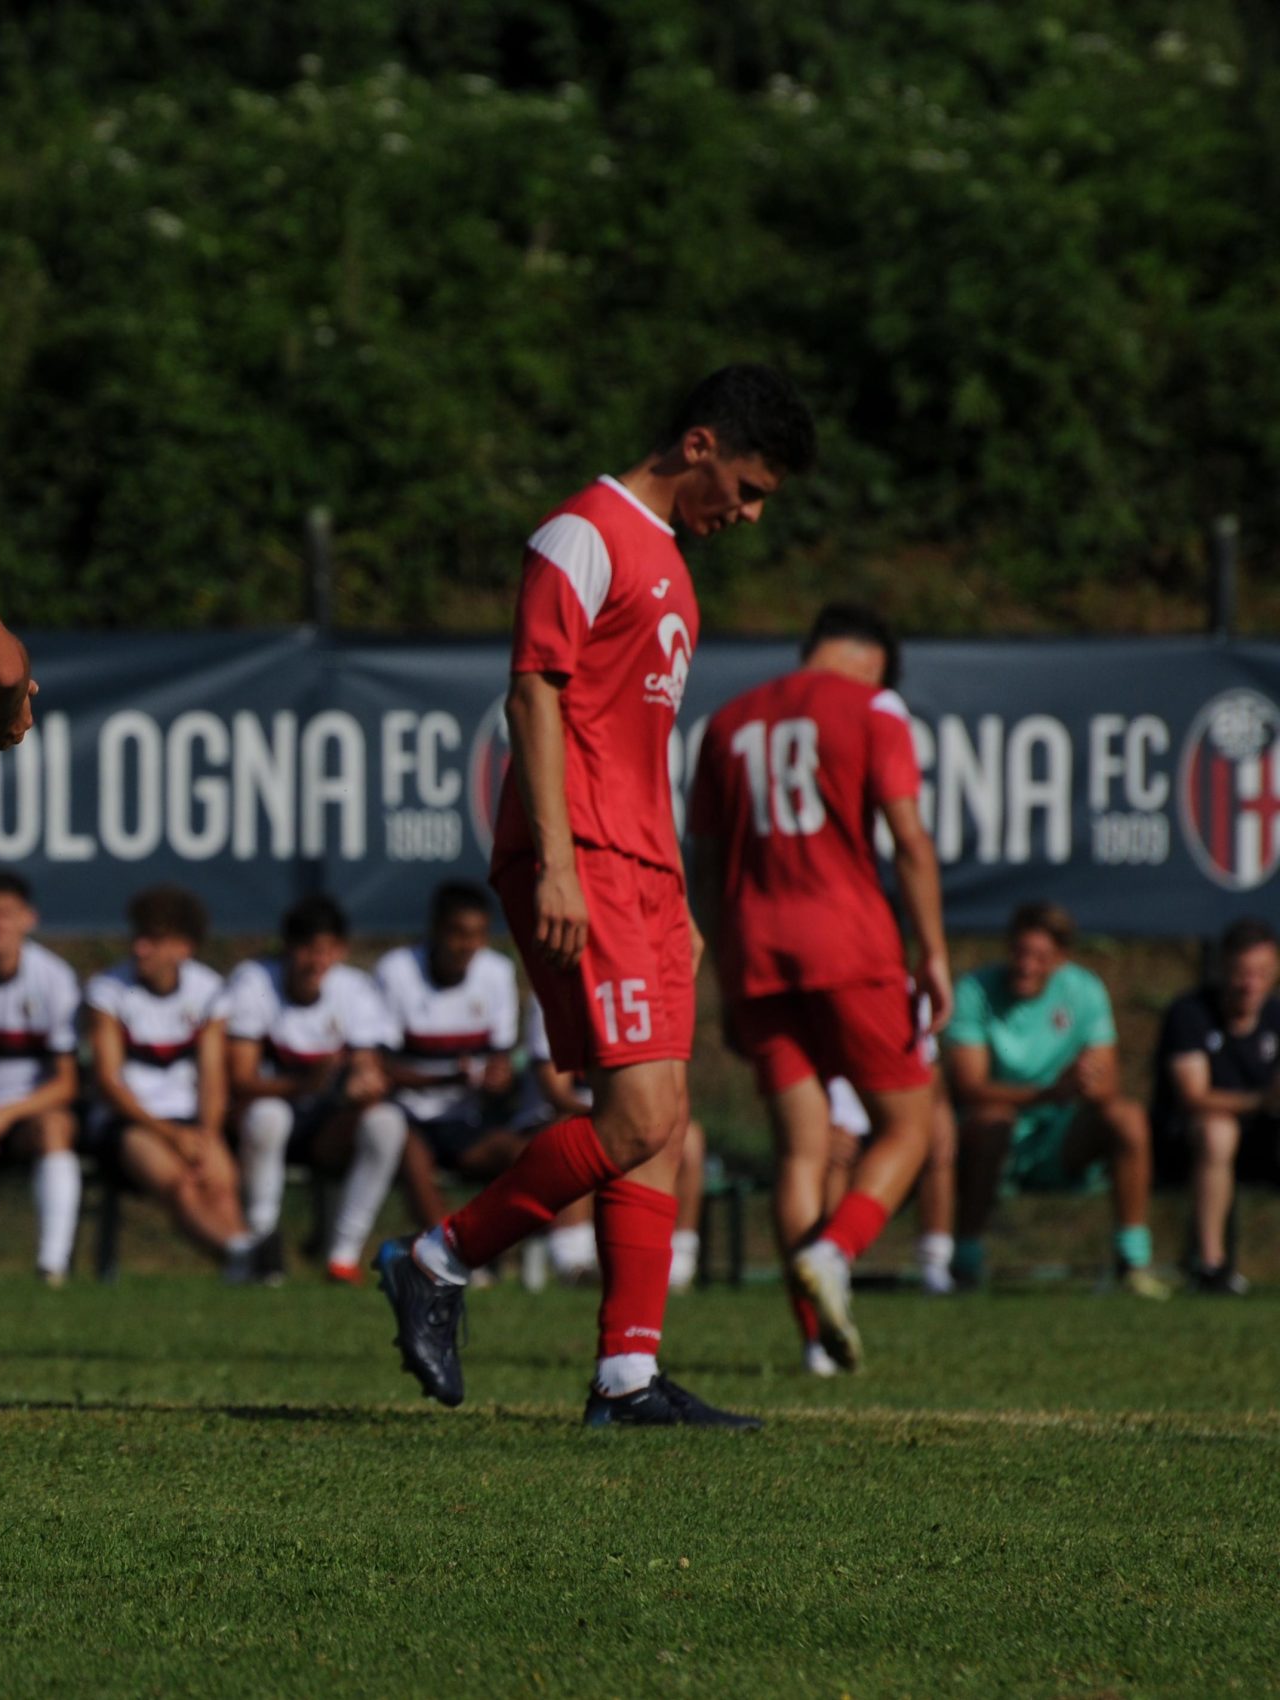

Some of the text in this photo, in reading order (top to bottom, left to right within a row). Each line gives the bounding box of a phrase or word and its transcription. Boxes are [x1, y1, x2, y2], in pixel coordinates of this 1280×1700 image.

[381, 710, 462, 808] FC
[732, 717, 826, 836] 18
[1089, 714, 1169, 812] FC
[595, 978, 652, 1044] 15
